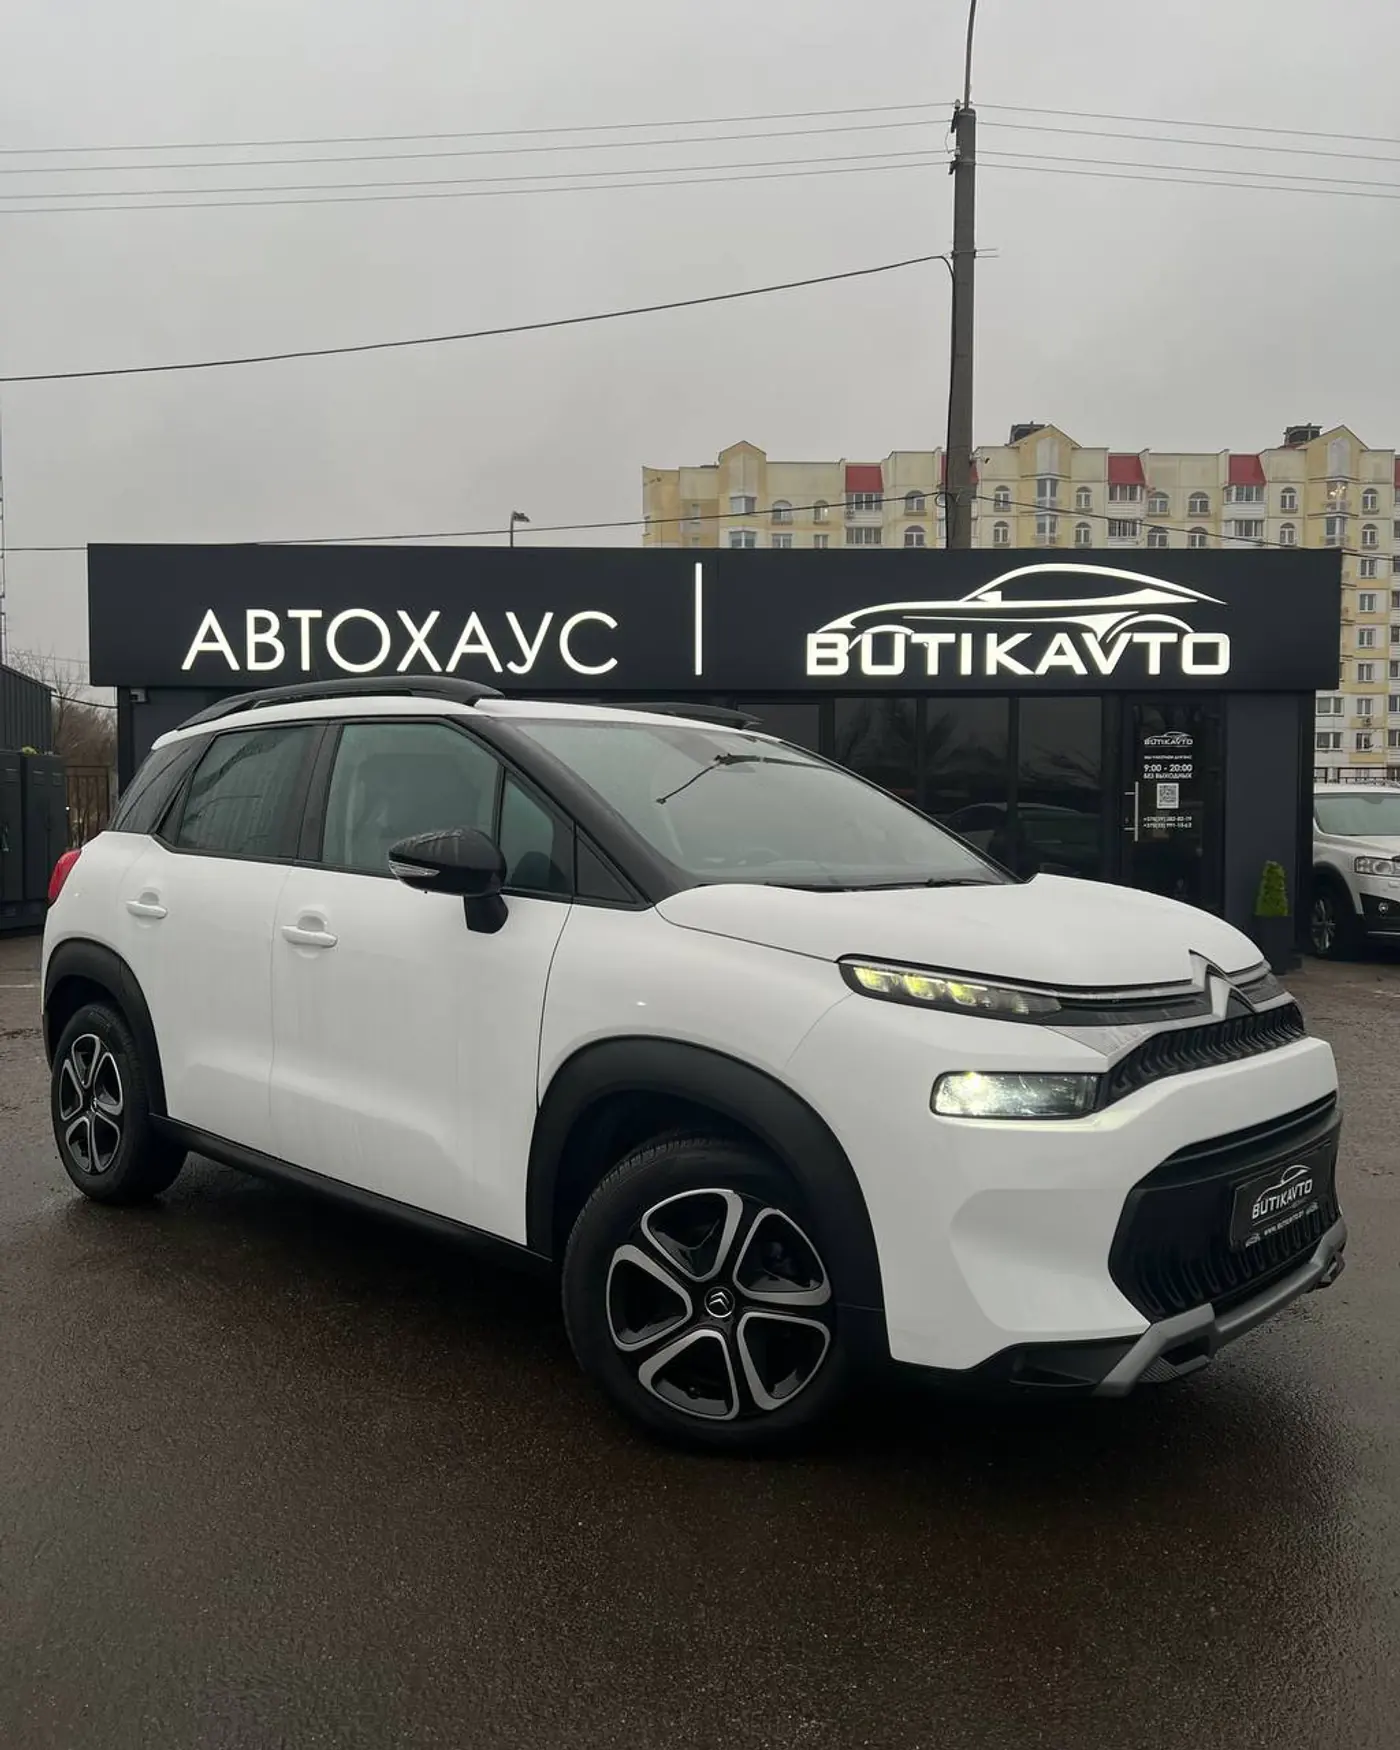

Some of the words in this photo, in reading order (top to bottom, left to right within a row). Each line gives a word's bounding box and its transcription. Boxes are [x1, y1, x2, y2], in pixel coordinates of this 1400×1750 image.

[181, 608, 618, 675] АВТОХАУС
[806, 633, 1231, 676] BUTIKAVTO
[1144, 764, 1162, 772] 9:00
[1169, 764, 1193, 772] 20:00
[1252, 1179, 1313, 1219] BUTIKAVTO
